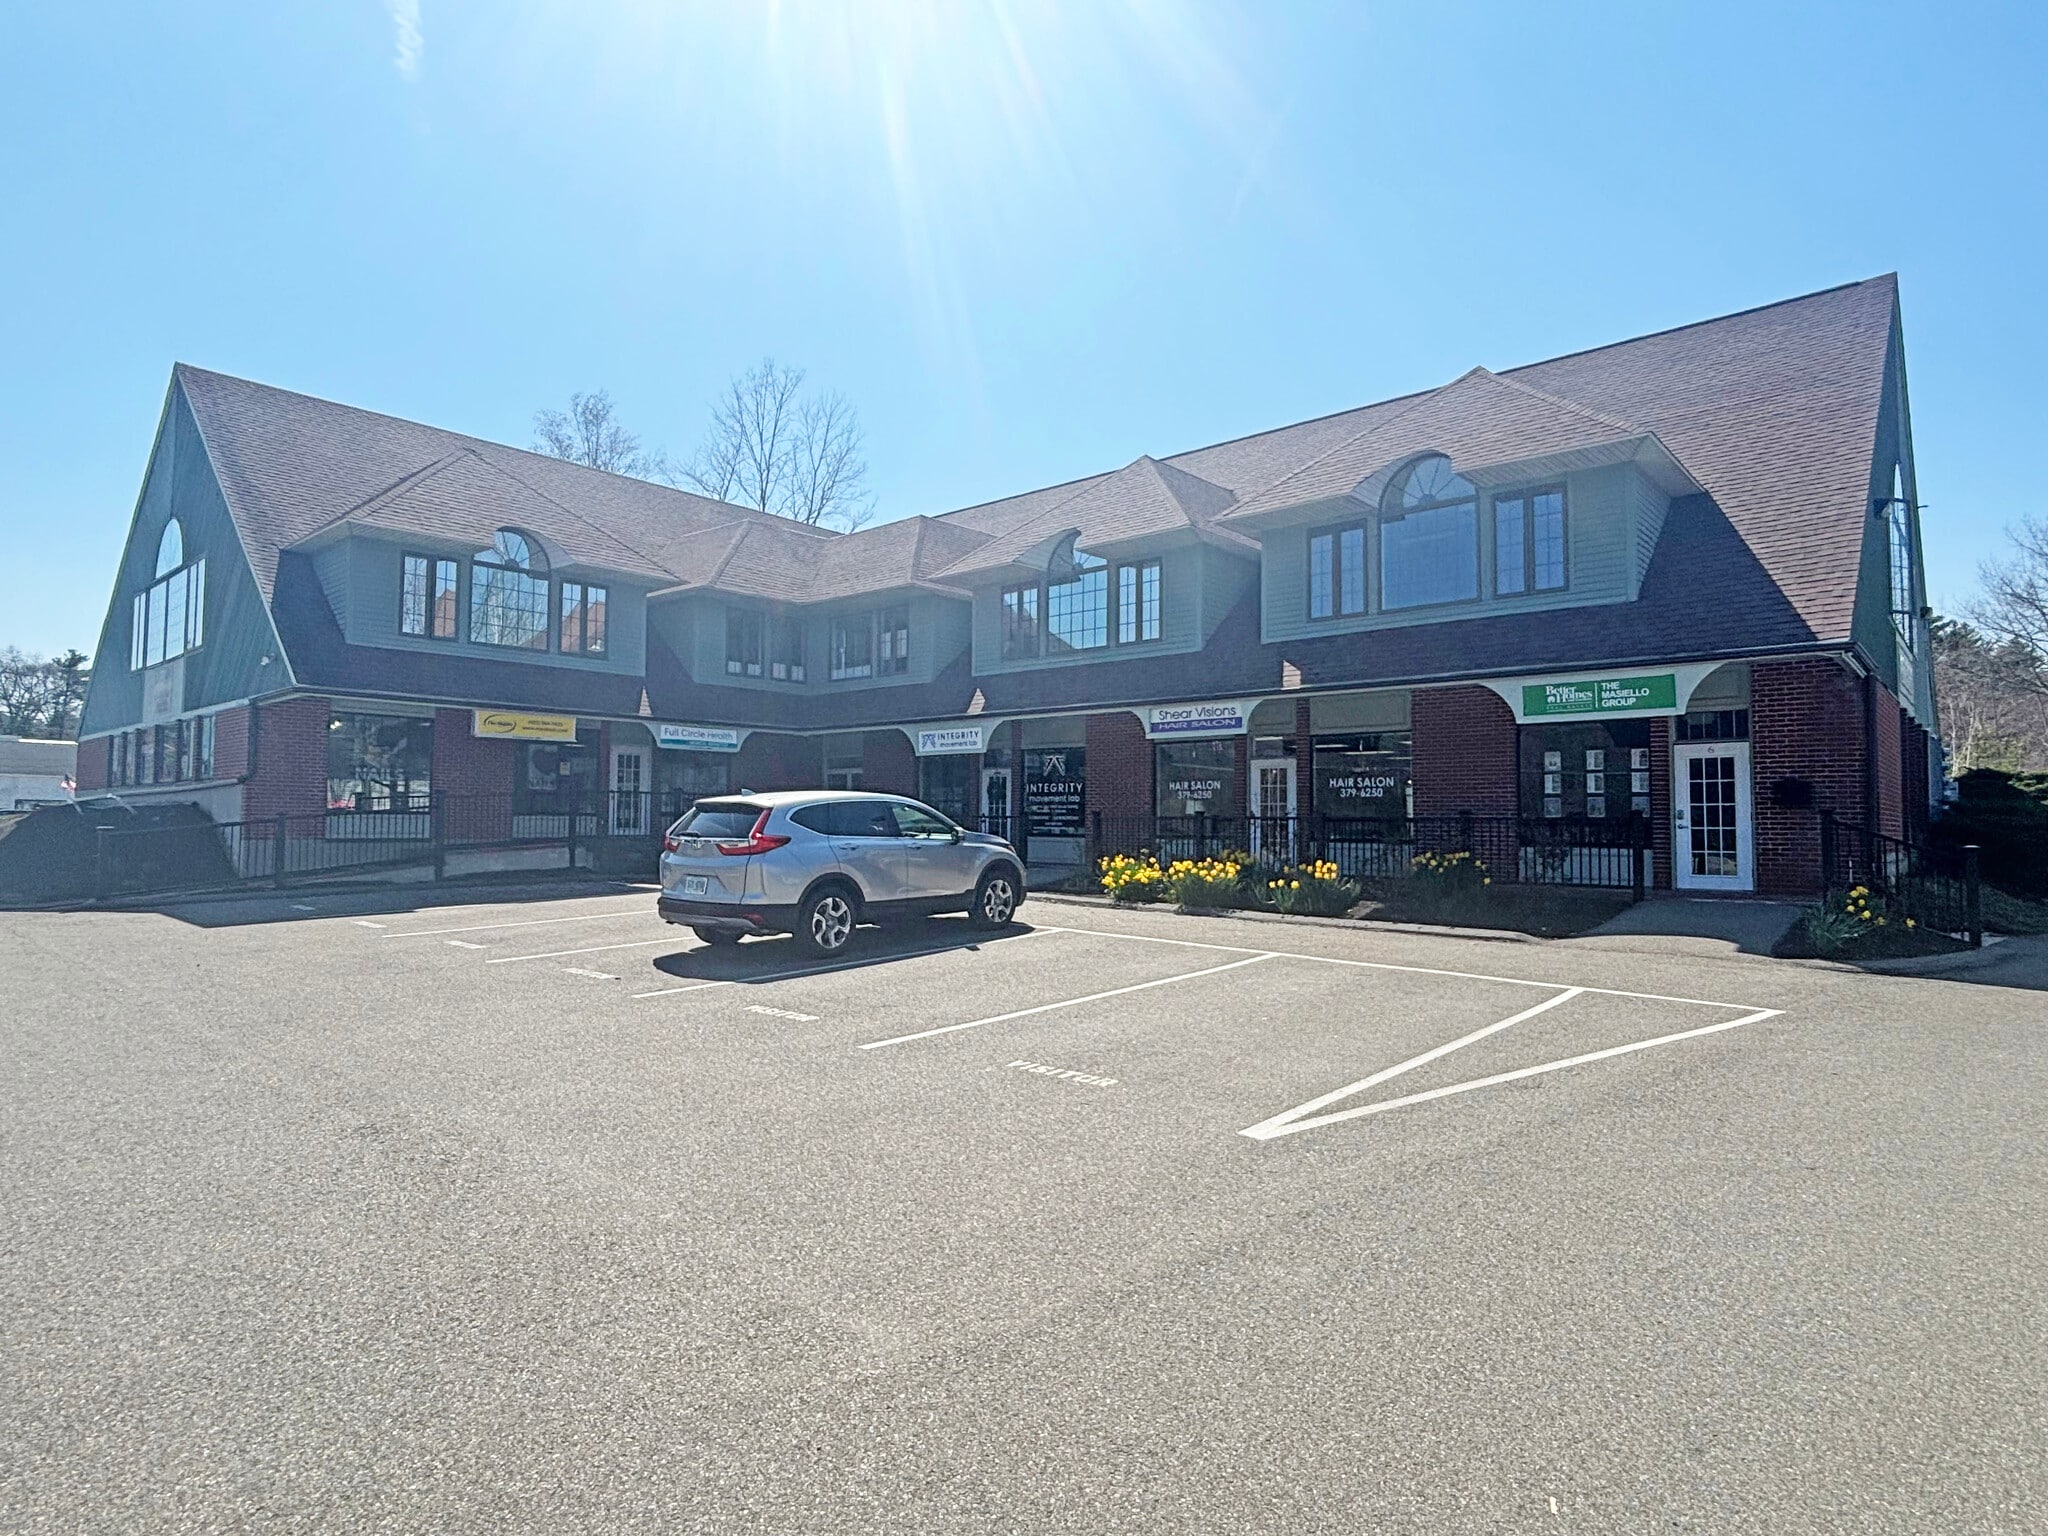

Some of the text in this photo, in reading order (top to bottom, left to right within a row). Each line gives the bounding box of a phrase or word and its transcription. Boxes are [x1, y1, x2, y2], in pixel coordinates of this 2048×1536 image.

[1546, 685, 1577, 696] Better
[1601, 682, 1620, 690] THE
[1601, 688, 1649, 699] MASIELLO
[1601, 697, 1637, 707] GROUP
[1159, 707, 1236, 720] Shear Visions
[664, 727, 679, 737] Full
[681, 728, 706, 739] Circle
[937, 730, 979, 741] INTEGRITY
[355, 767, 405, 781] NAILS
[1026, 782, 1084, 793] INTEGRITY
[1168, 780, 1221, 791] HAIR SALON
[1329, 776, 1395, 788] HAIR SALON
[1176, 790, 1213, 800] 379-6250
[1339, 788, 1384, 798] 379-6250
[1004, 1059, 1119, 1087] VISITOR
